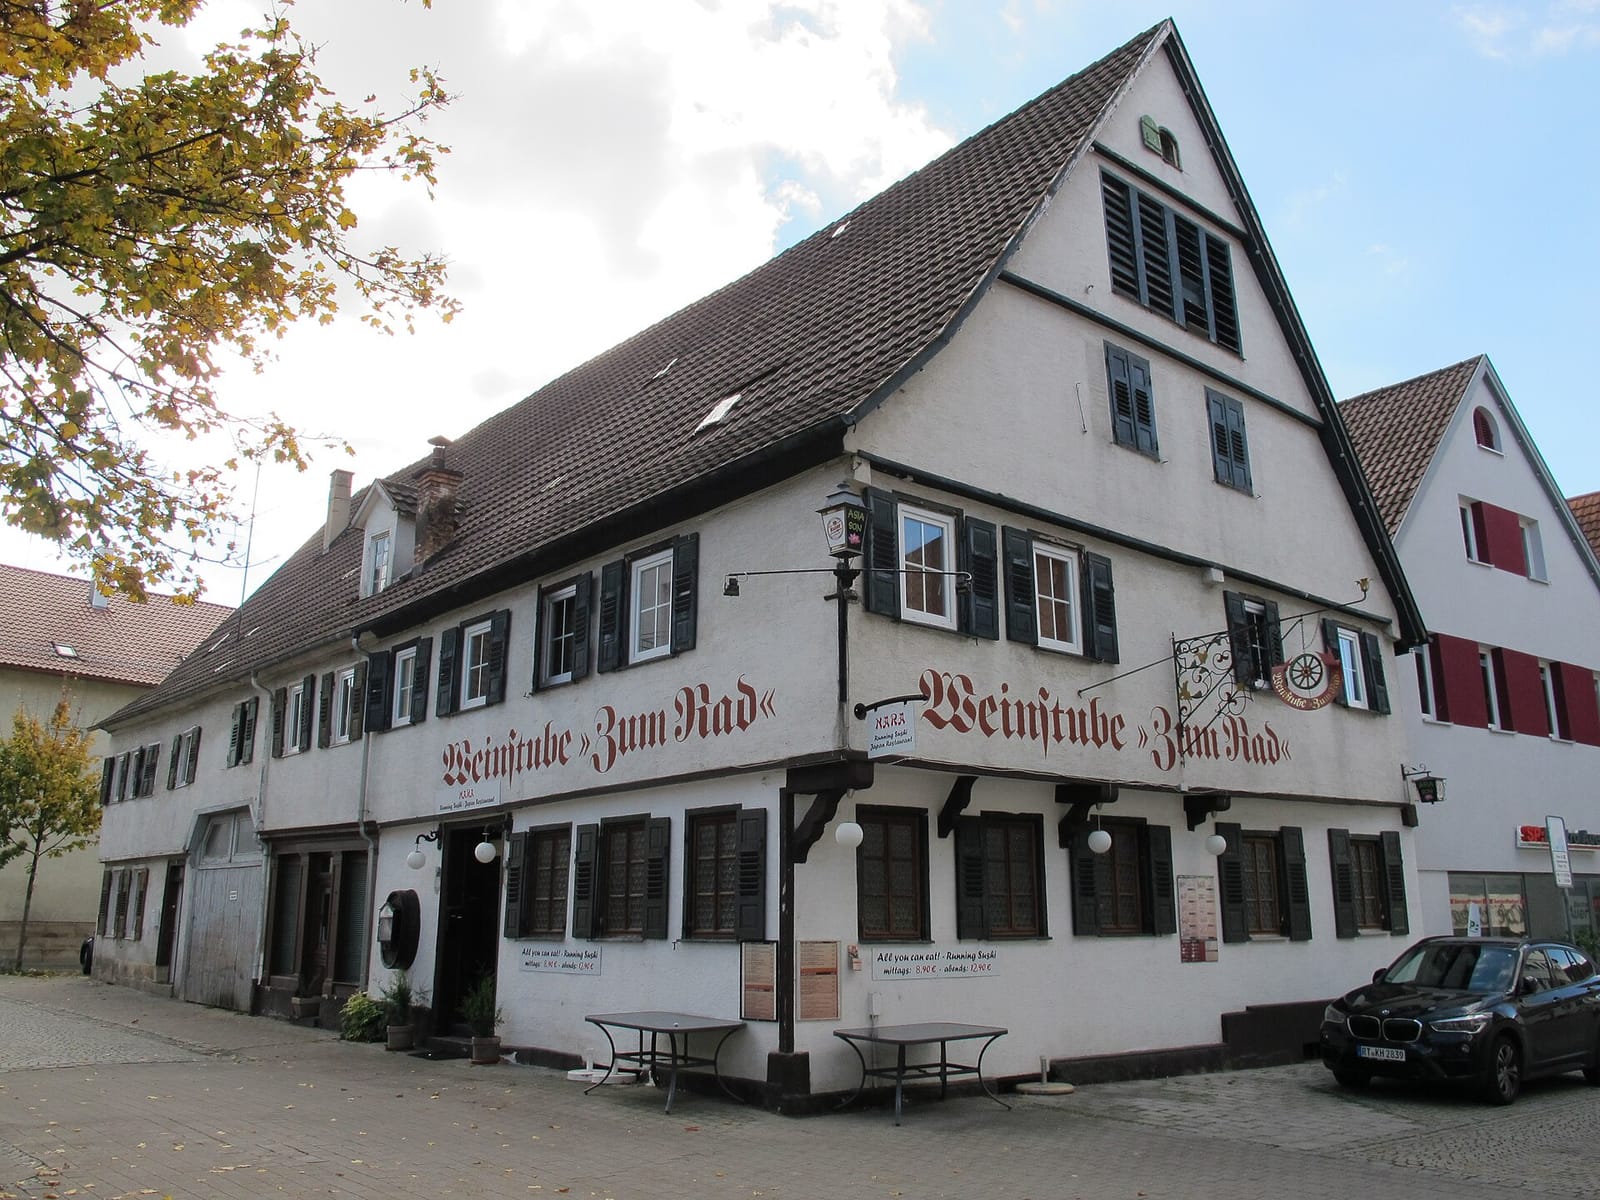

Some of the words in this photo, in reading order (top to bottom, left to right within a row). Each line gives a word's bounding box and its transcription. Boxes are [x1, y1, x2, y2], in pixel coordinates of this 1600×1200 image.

[894, 729, 907, 738] Sushi
[870, 743, 885, 751] Japan
[886, 736, 913, 747] Restaurant
[877, 952, 892, 962] All
[895, 953, 908, 963] you
[911, 953, 924, 961] can
[926, 952, 940, 961] eat!
[946, 951, 976, 961] Running
[978, 950, 997, 960] Sushi
[884, 966, 912, 976] mittags:
